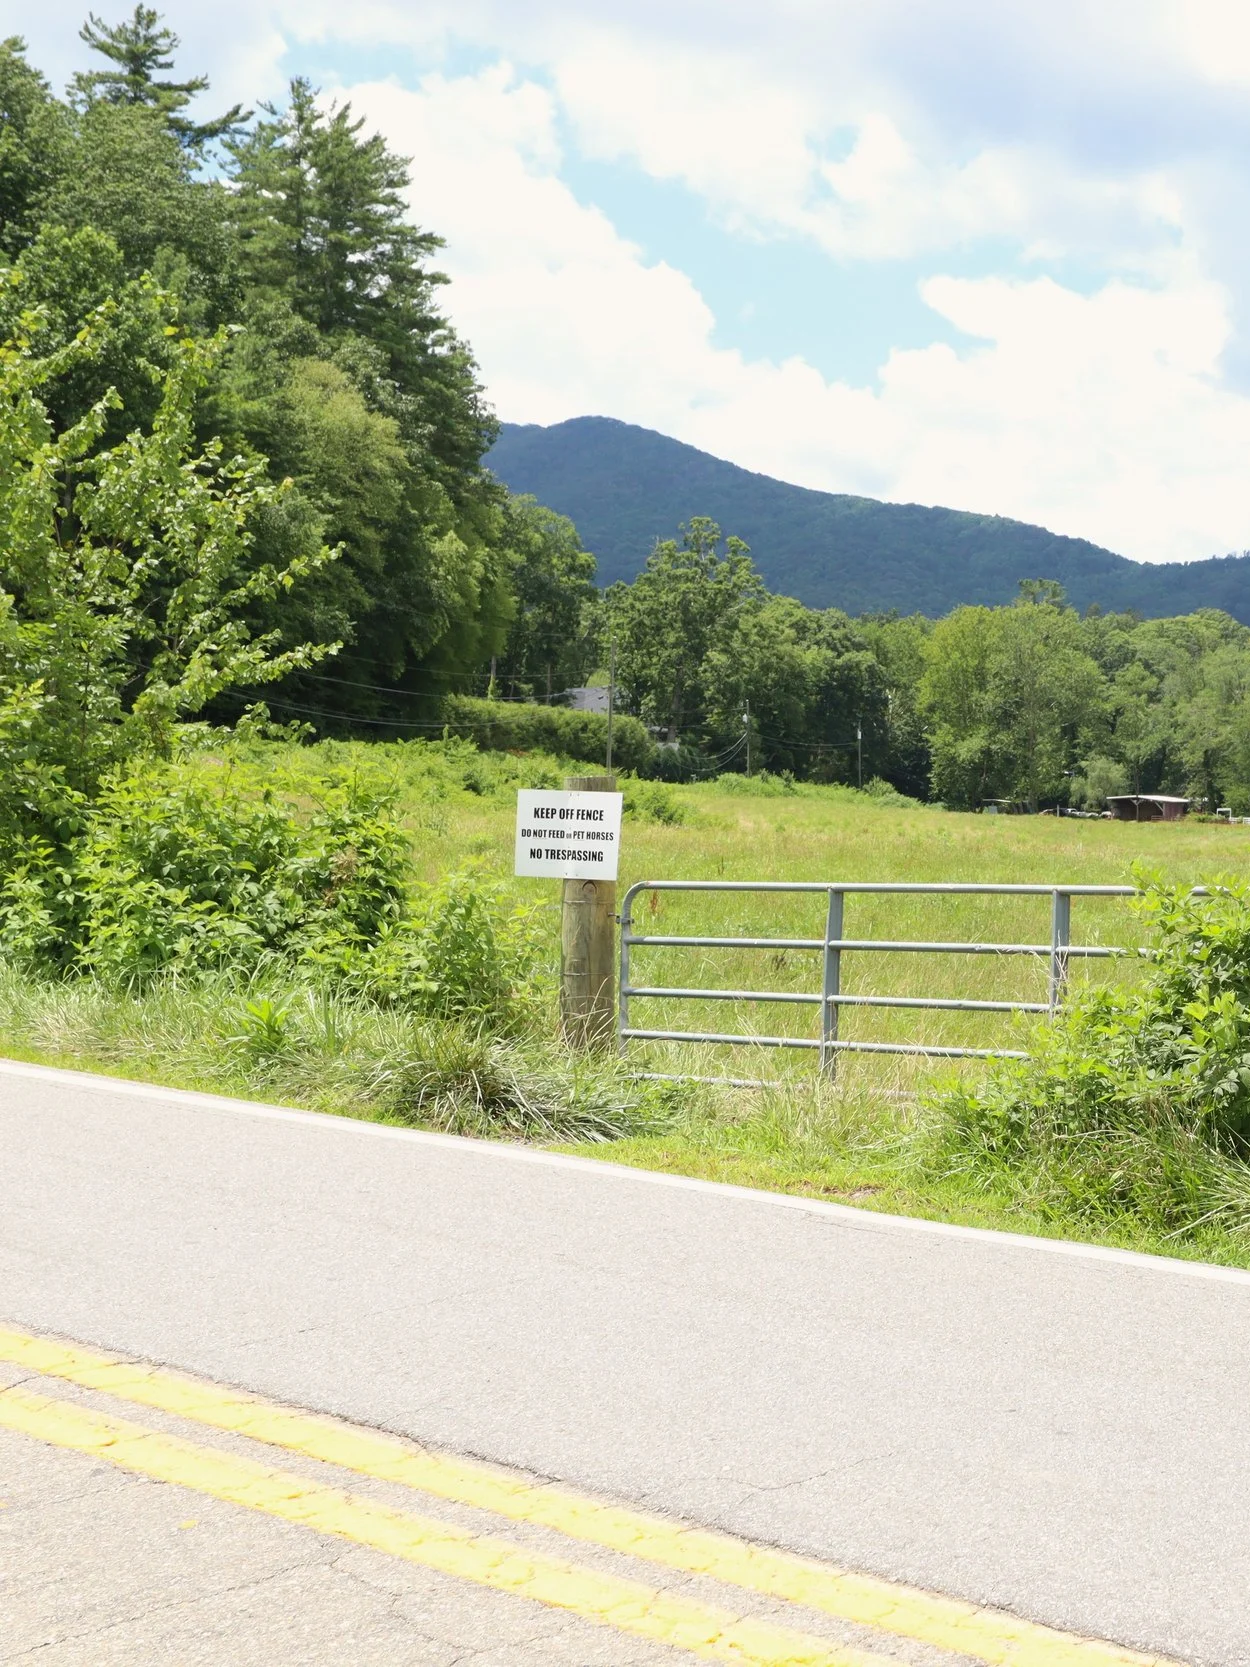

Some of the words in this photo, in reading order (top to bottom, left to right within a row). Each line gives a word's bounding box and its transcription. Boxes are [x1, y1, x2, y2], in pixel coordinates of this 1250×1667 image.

[533, 807, 557, 819] KEEP
[559, 808, 575, 820] OFF
[576, 809, 604, 821] FENCE
[521, 829, 532, 838] DO
[533, 829, 547, 838] NOT
[548, 830, 565, 839] FEED
[573, 831, 585, 840] PET
[586, 831, 614, 841] HORSES
[530, 848, 542, 859] NO
[545, 849, 604, 862] TRESPASSING
